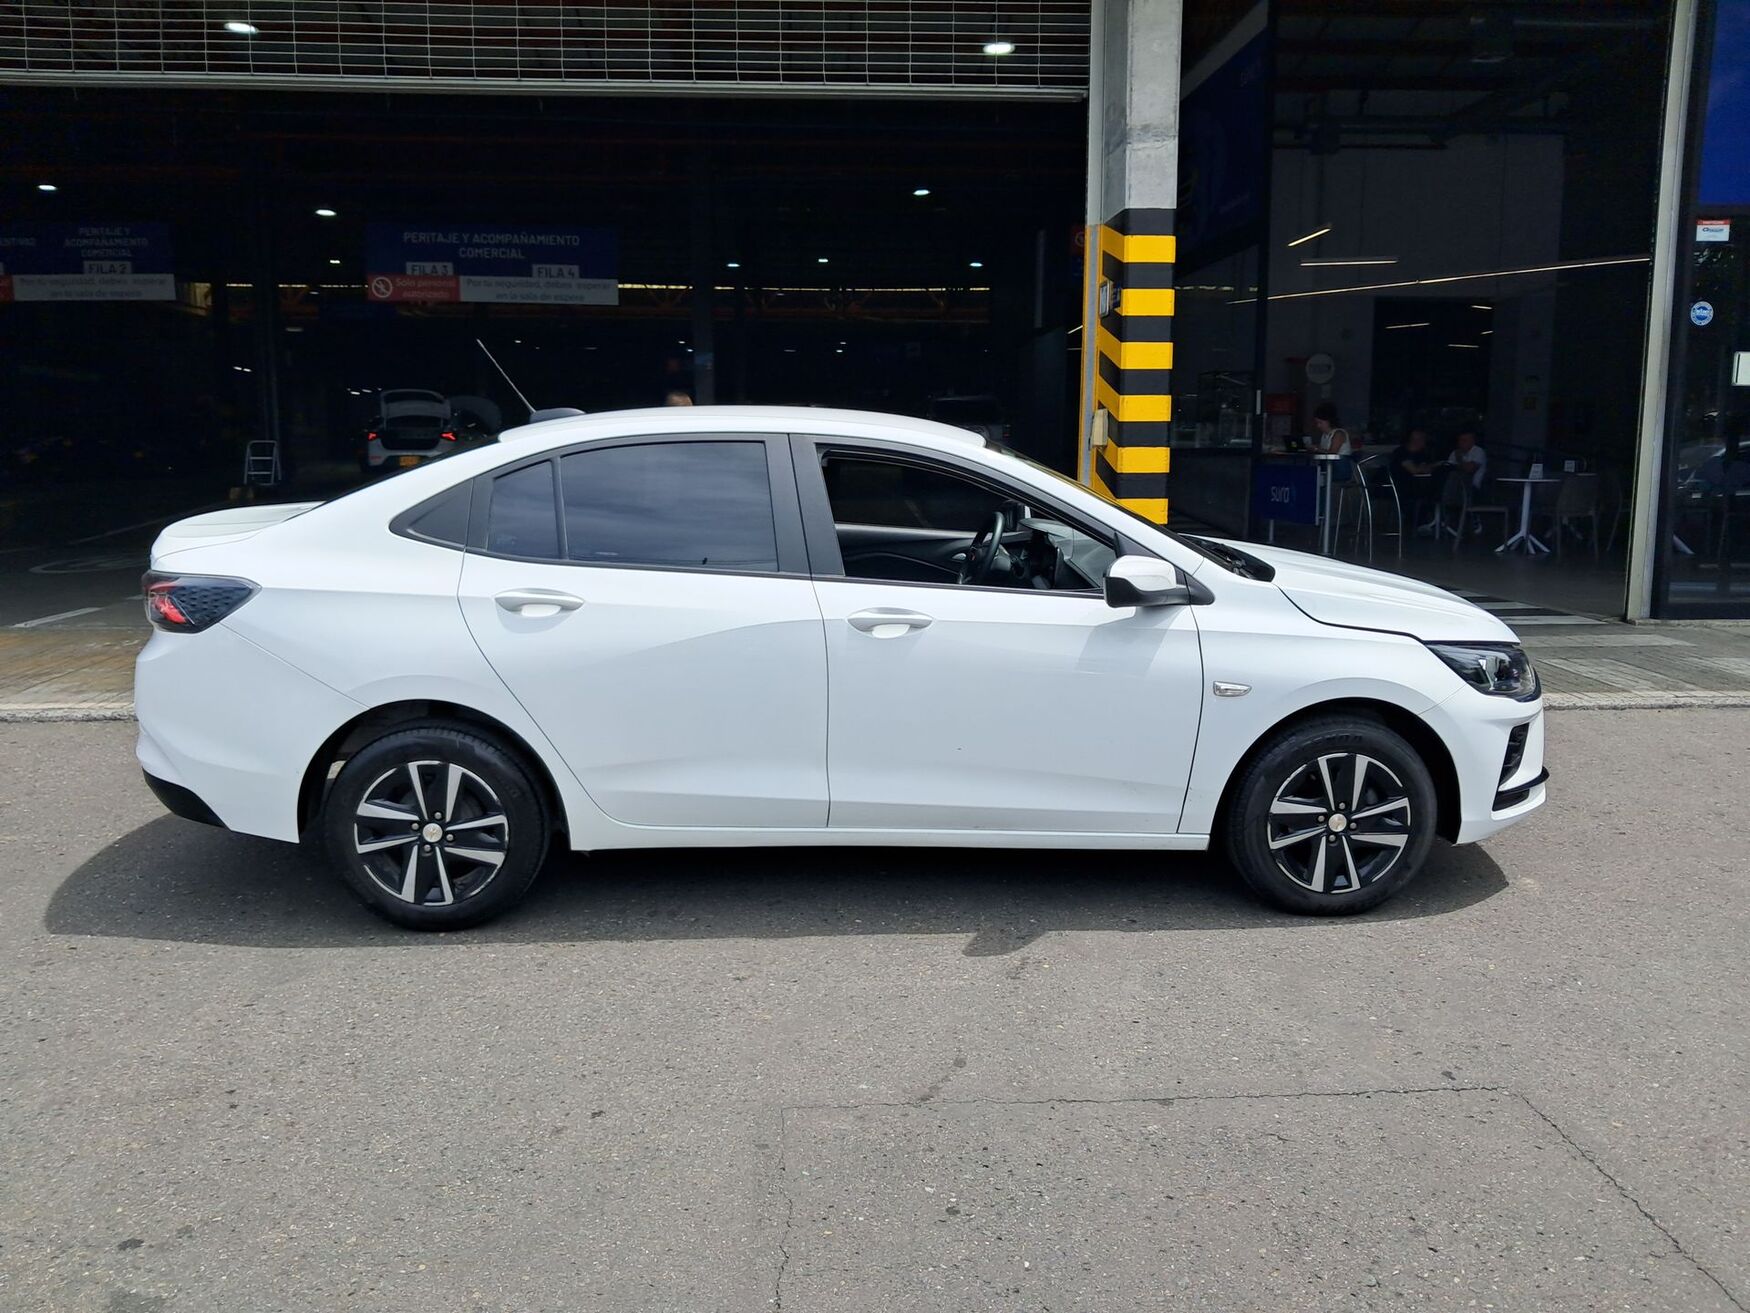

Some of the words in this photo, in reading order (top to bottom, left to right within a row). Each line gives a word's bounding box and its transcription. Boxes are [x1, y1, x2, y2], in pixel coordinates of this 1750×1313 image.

[403, 231, 459, 244] PERITAJE
[462, 232, 470, 244] Y
[472, 231, 580, 246] ACOMPAÑAMIENTO
[459, 247, 526, 260] COMERCIAL
[88, 263, 117, 274] FILA
[411, 264, 437, 276] FILA
[441, 265, 449, 276] 3
[537, 267, 565, 278] FILA
[567, 268, 575, 278] 4
